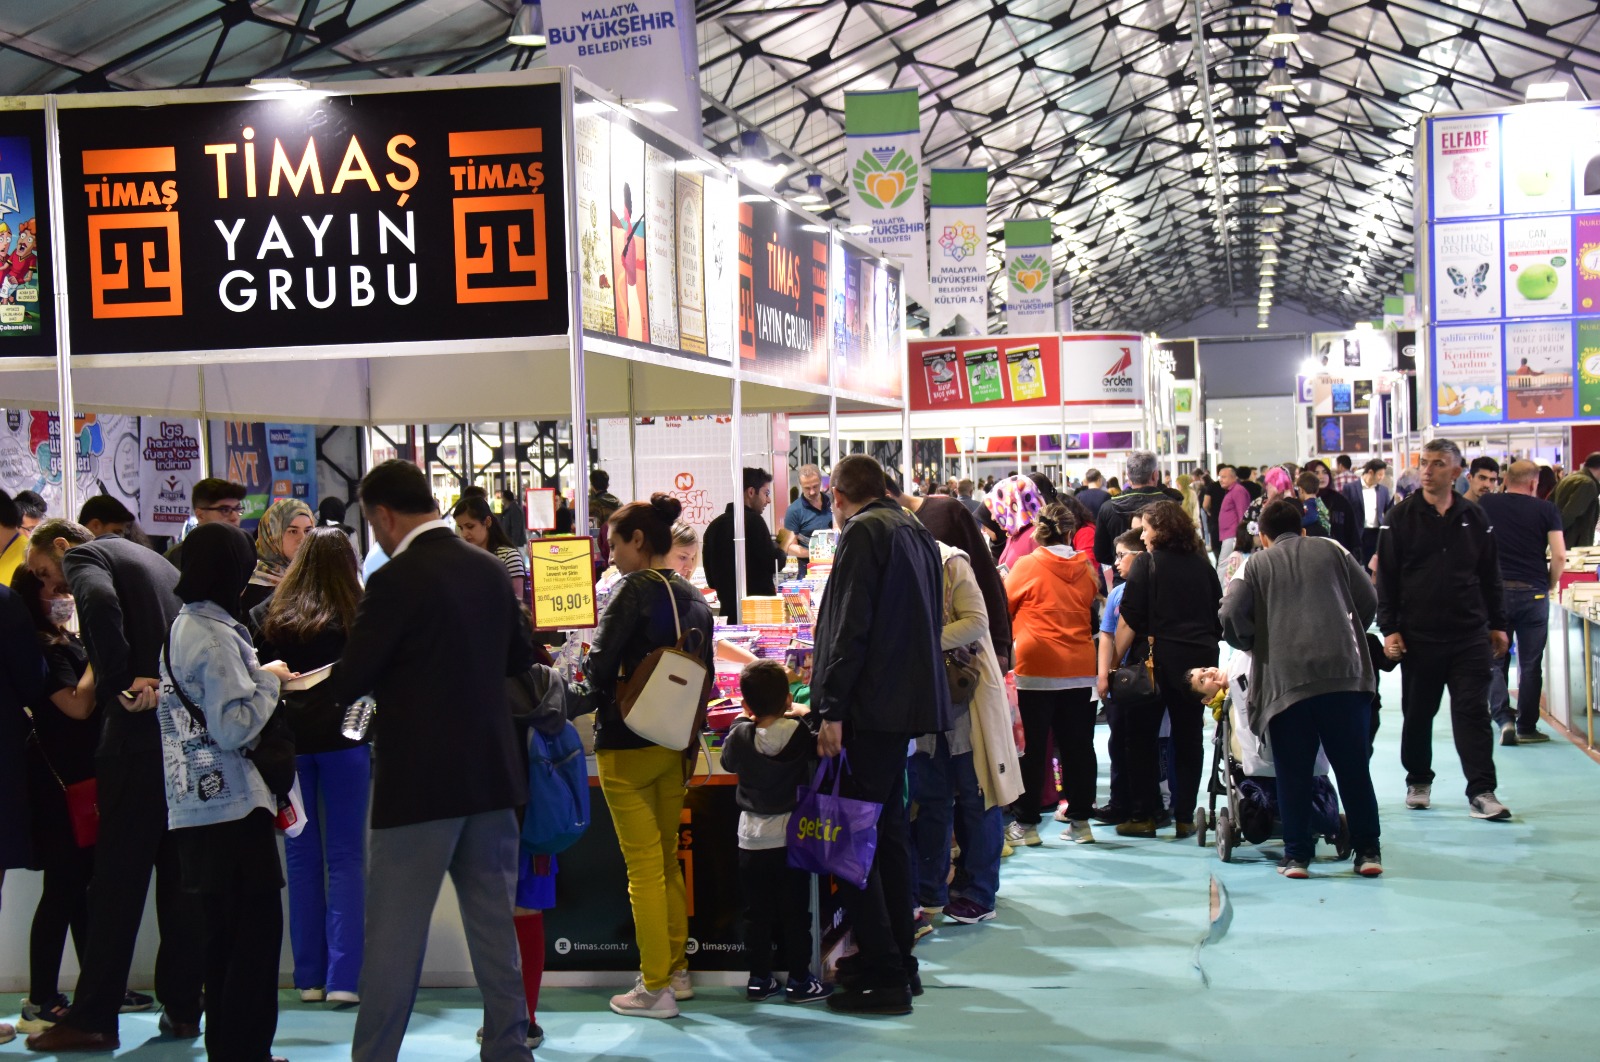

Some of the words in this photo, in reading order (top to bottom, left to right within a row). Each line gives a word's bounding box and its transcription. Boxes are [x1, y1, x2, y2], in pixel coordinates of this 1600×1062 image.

[581, 2, 639, 22] MALATYA
[548, 11, 675, 45] BÜYÜKŞEHİR
[577, 34, 652, 57] BELEDİYESİ
[1441, 130, 1489, 149] ELFABE
[205, 127, 419, 207] TİMAŞ
[450, 159, 544, 194] TİMAŞ
[84, 177, 178, 211] TİMAŞ
[853, 223, 925, 236] YÜKŞEHİR
[872, 217, 905, 228] MALATYA
[214, 210, 416, 261] YAYIN
[767, 232, 800, 312] TİMAŞ
[931, 275, 986, 284] BÜYÜKŞEHİR
[941, 266, 977, 274] MALATYA
[219, 263, 419, 312] GRUBU
[934, 295, 967, 304] KÜLTÜR
[756, 302, 783, 346] YAYIN
[784, 312, 812, 352] GRUBU
[1443, 350, 1493, 361] Kendime
[1102, 375, 1132, 386] erdem
[144, 449, 174, 460] fuara
[228, 450, 259, 487] AYT
[154, 505, 190, 514] SENTEZ
[797, 817, 842, 842] getir
[573, 942, 628, 952] timas.com.tr
